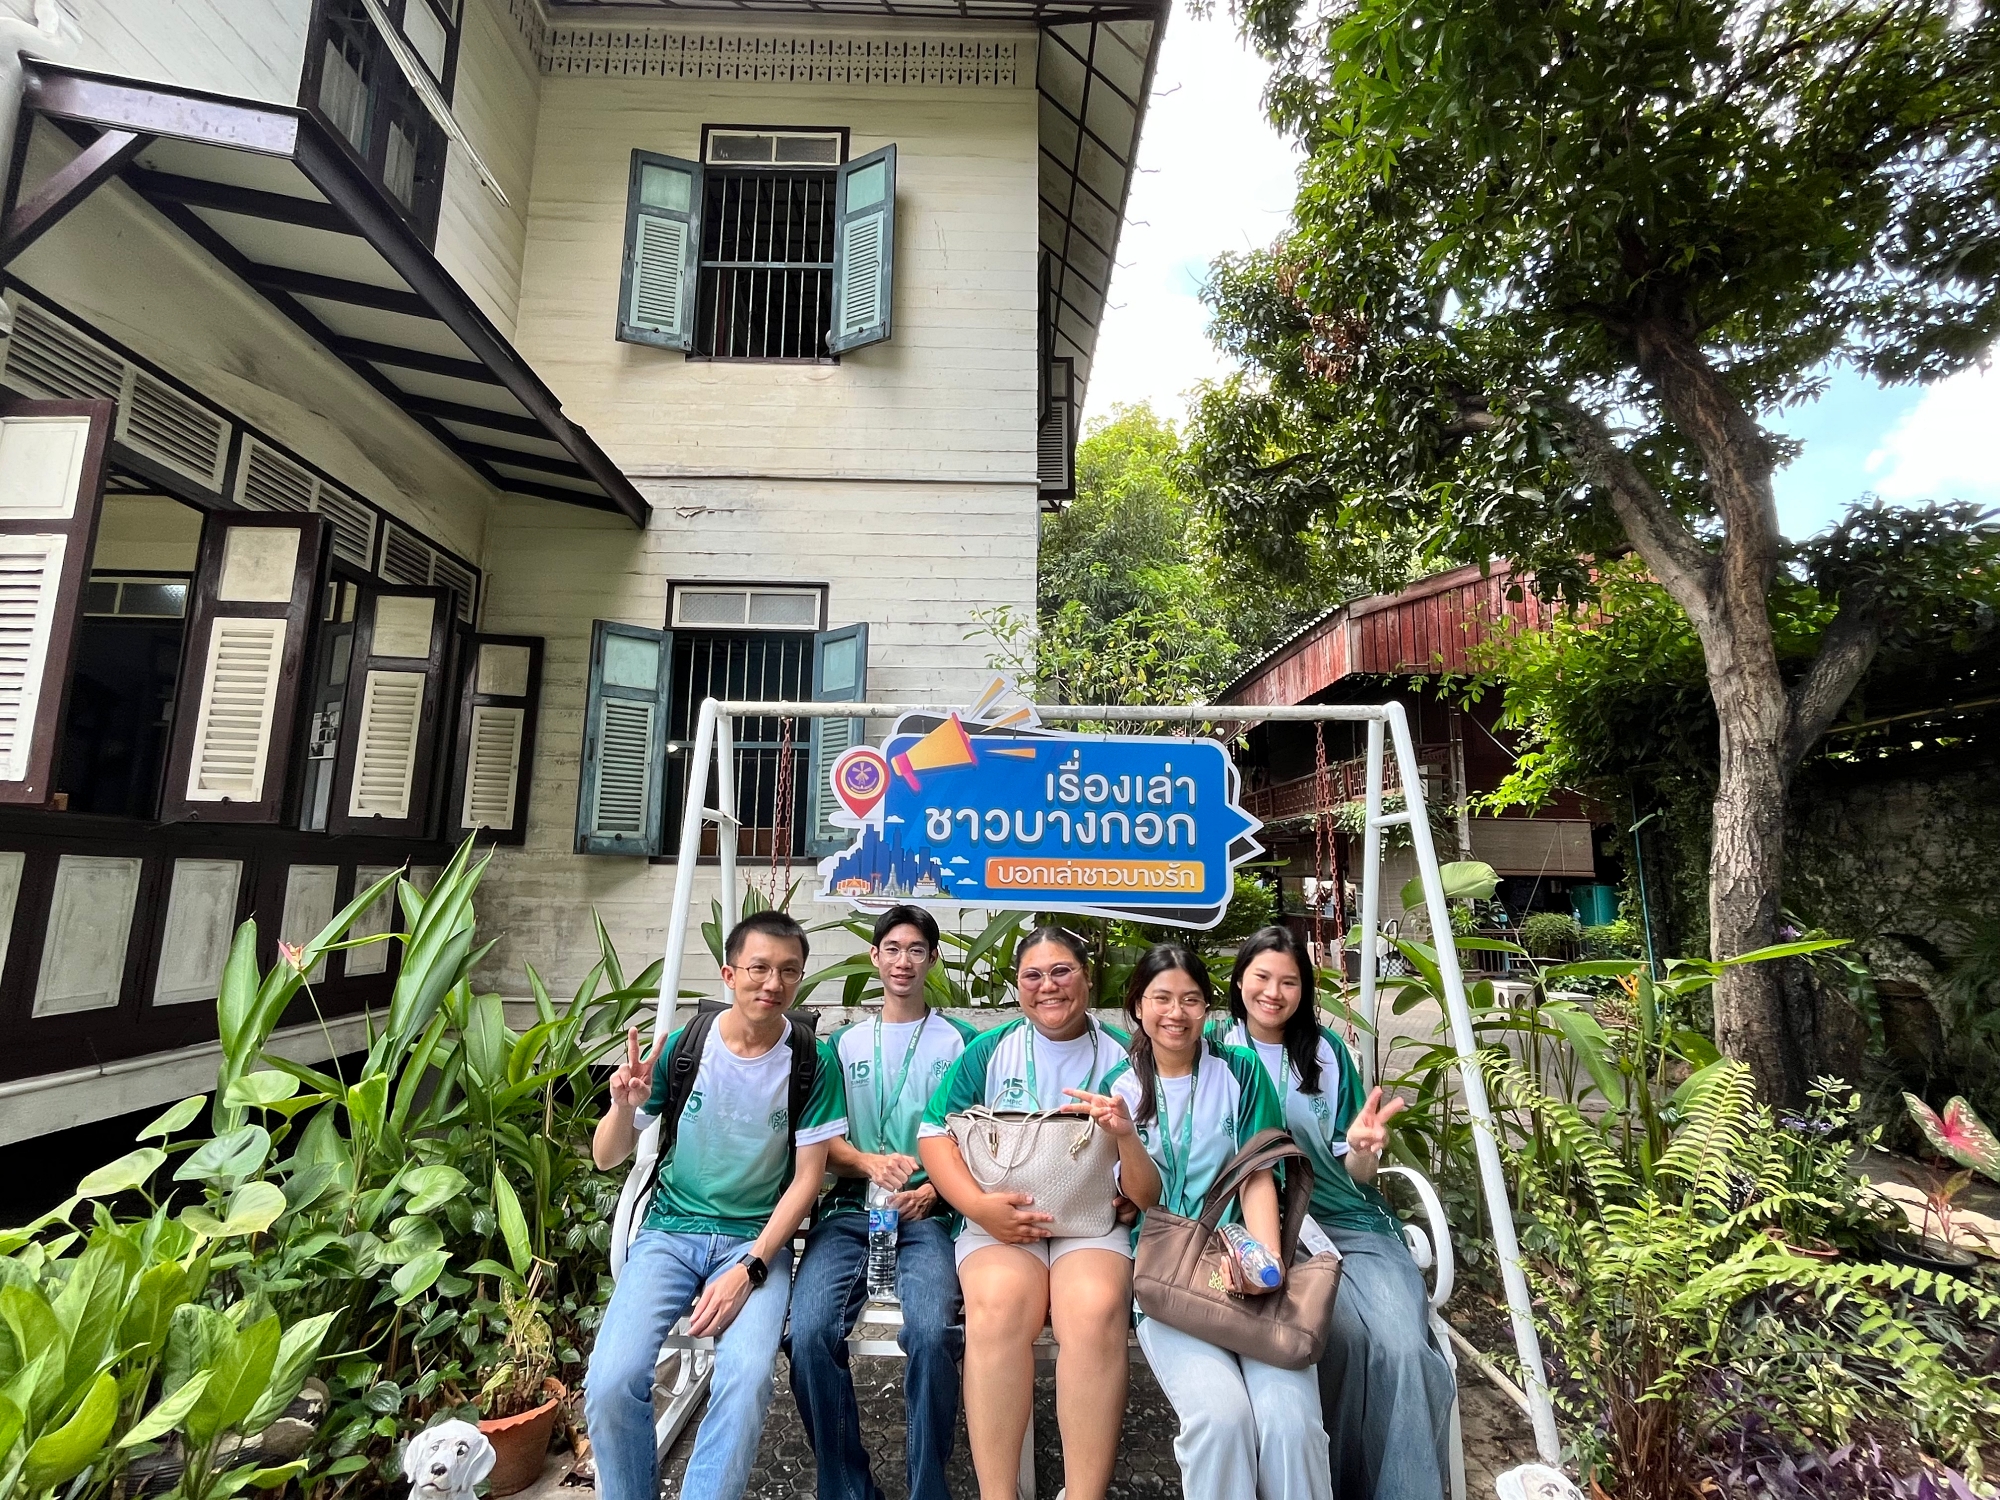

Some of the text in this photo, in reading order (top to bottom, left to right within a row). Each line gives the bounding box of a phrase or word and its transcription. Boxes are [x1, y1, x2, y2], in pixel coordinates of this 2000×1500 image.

[1047, 749, 1196, 805] เรื่องเล่า
[925, 807, 1196, 846] ชาวบางกอก
[997, 861, 1196, 887] บอกเล่าชาวบางรัก
[687, 1091, 703, 1113] 5
[683, 1111, 699, 1121] MPIC
